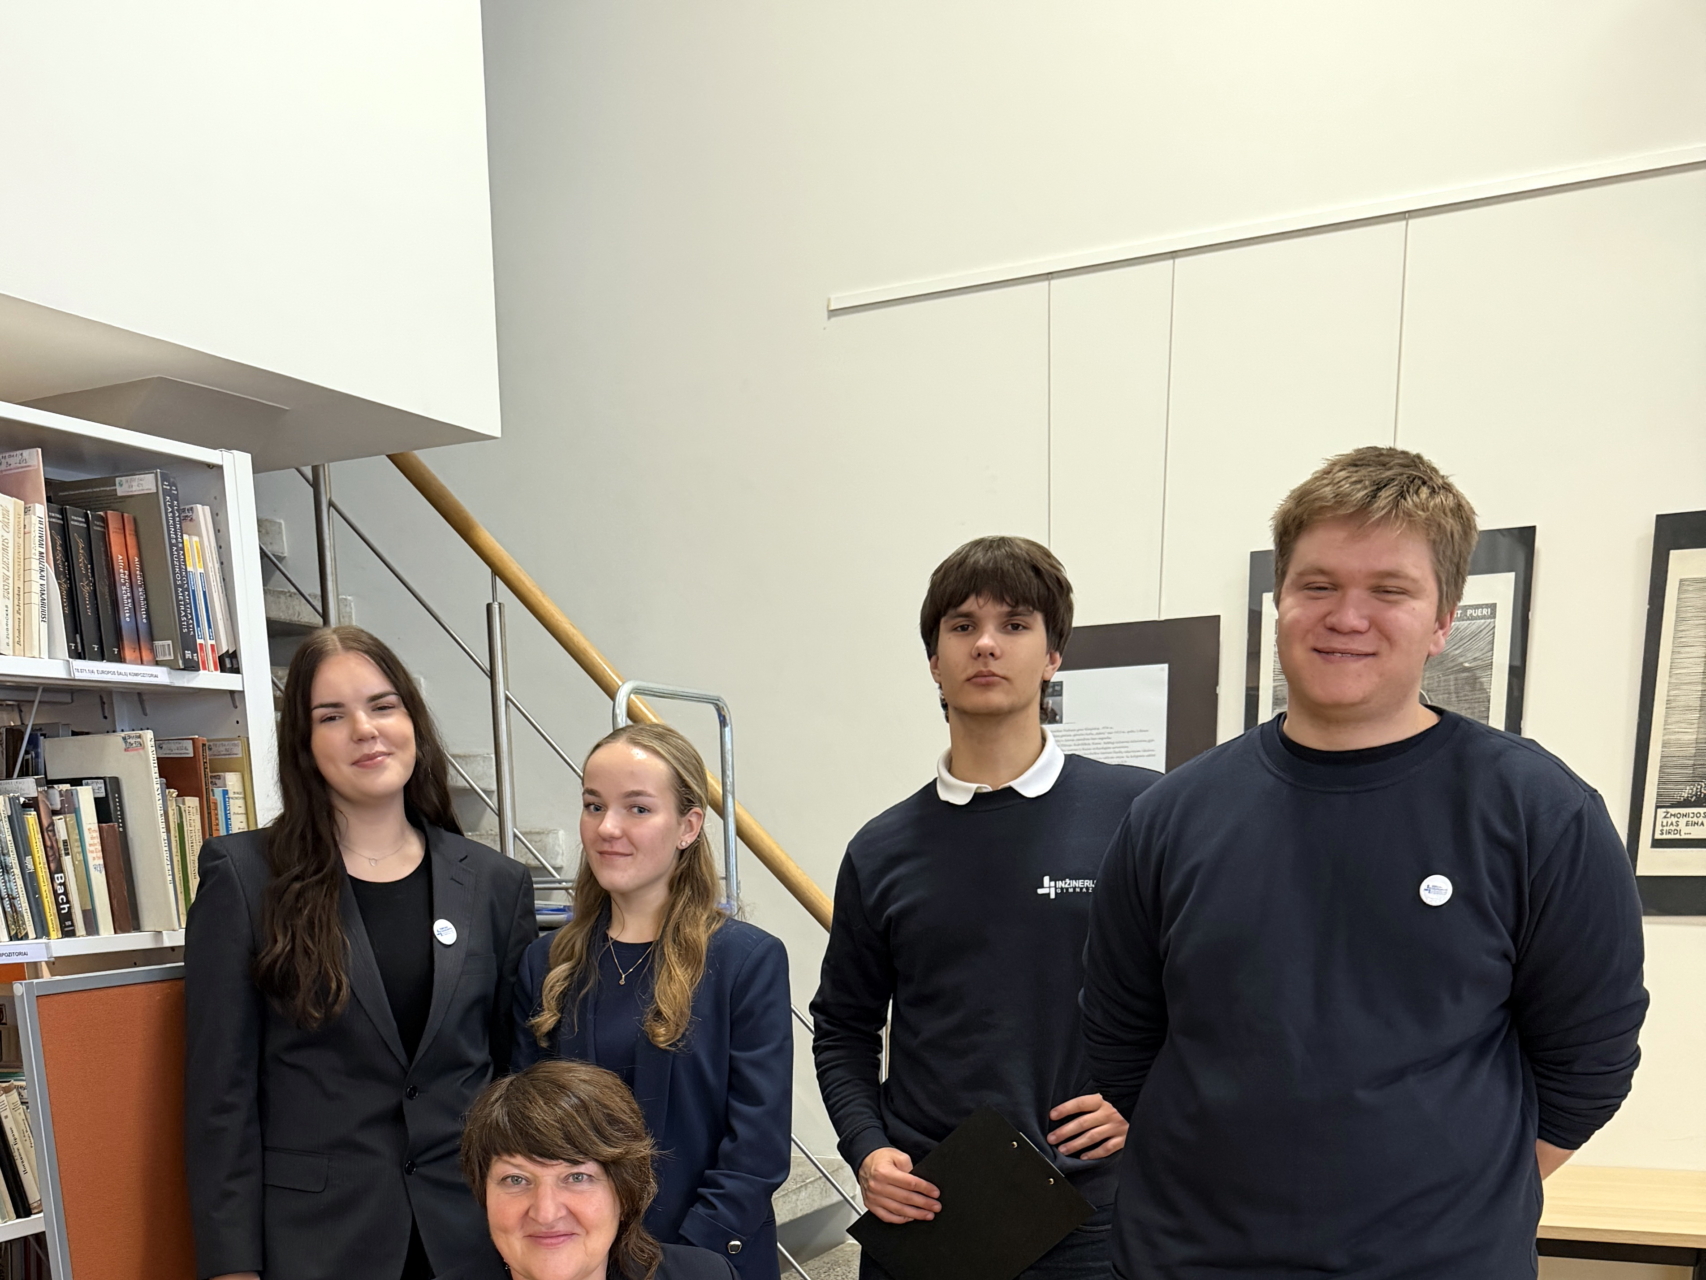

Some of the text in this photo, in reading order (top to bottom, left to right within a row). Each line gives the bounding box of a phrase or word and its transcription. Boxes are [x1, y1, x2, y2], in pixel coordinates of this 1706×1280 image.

[1467, 608, 1491, 617] PUERI
[1661, 820, 1680, 828] LIAS
[54, 873, 70, 914] Bach
